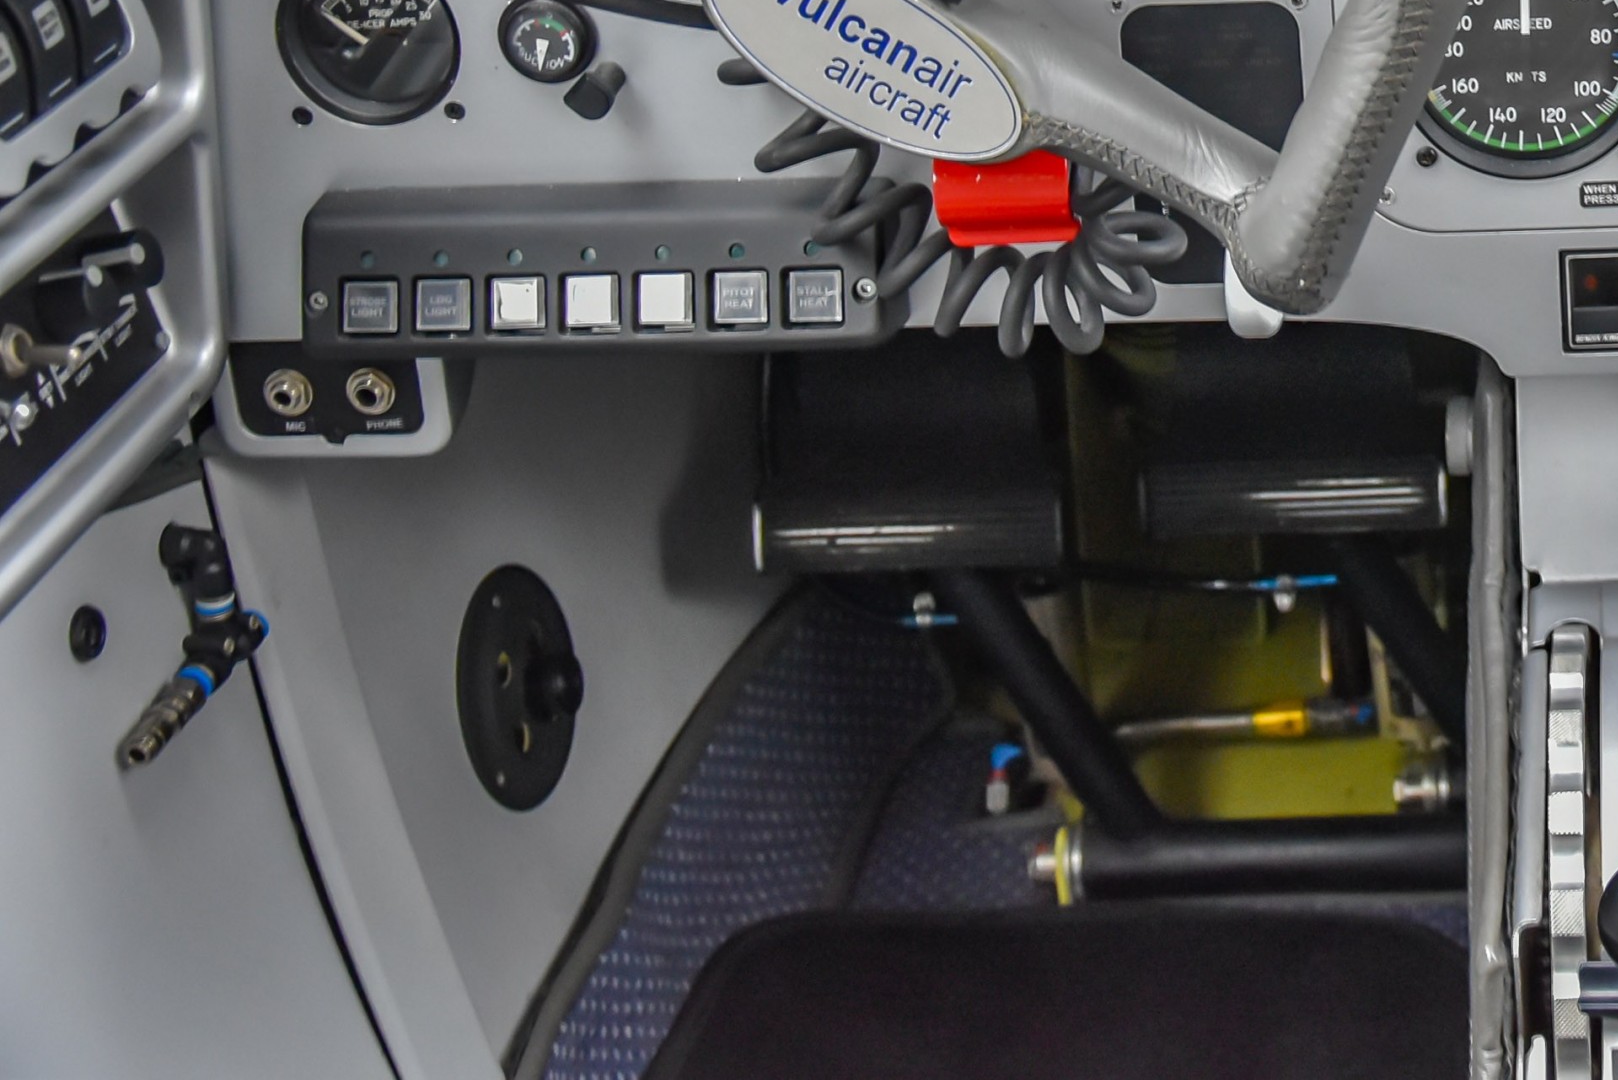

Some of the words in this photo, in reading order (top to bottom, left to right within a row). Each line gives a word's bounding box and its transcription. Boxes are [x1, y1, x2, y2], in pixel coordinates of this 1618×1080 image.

[369, 8, 393, 18] PROP
[390, 18, 417, 27] AMPS
[1590, 29, 1611, 44] 80
[1452, 78, 1479, 94] 160
[1574, 81, 1600, 97] 100
[824, 56, 951, 140] aircraft
[1489, 107, 1517, 122] 140
[1541, 107, 1567, 122] 120
[1583, 184, 1617, 194] WHEN
[724, 298, 754, 310] HEAT
[366, 418, 403, 431] PHONE
